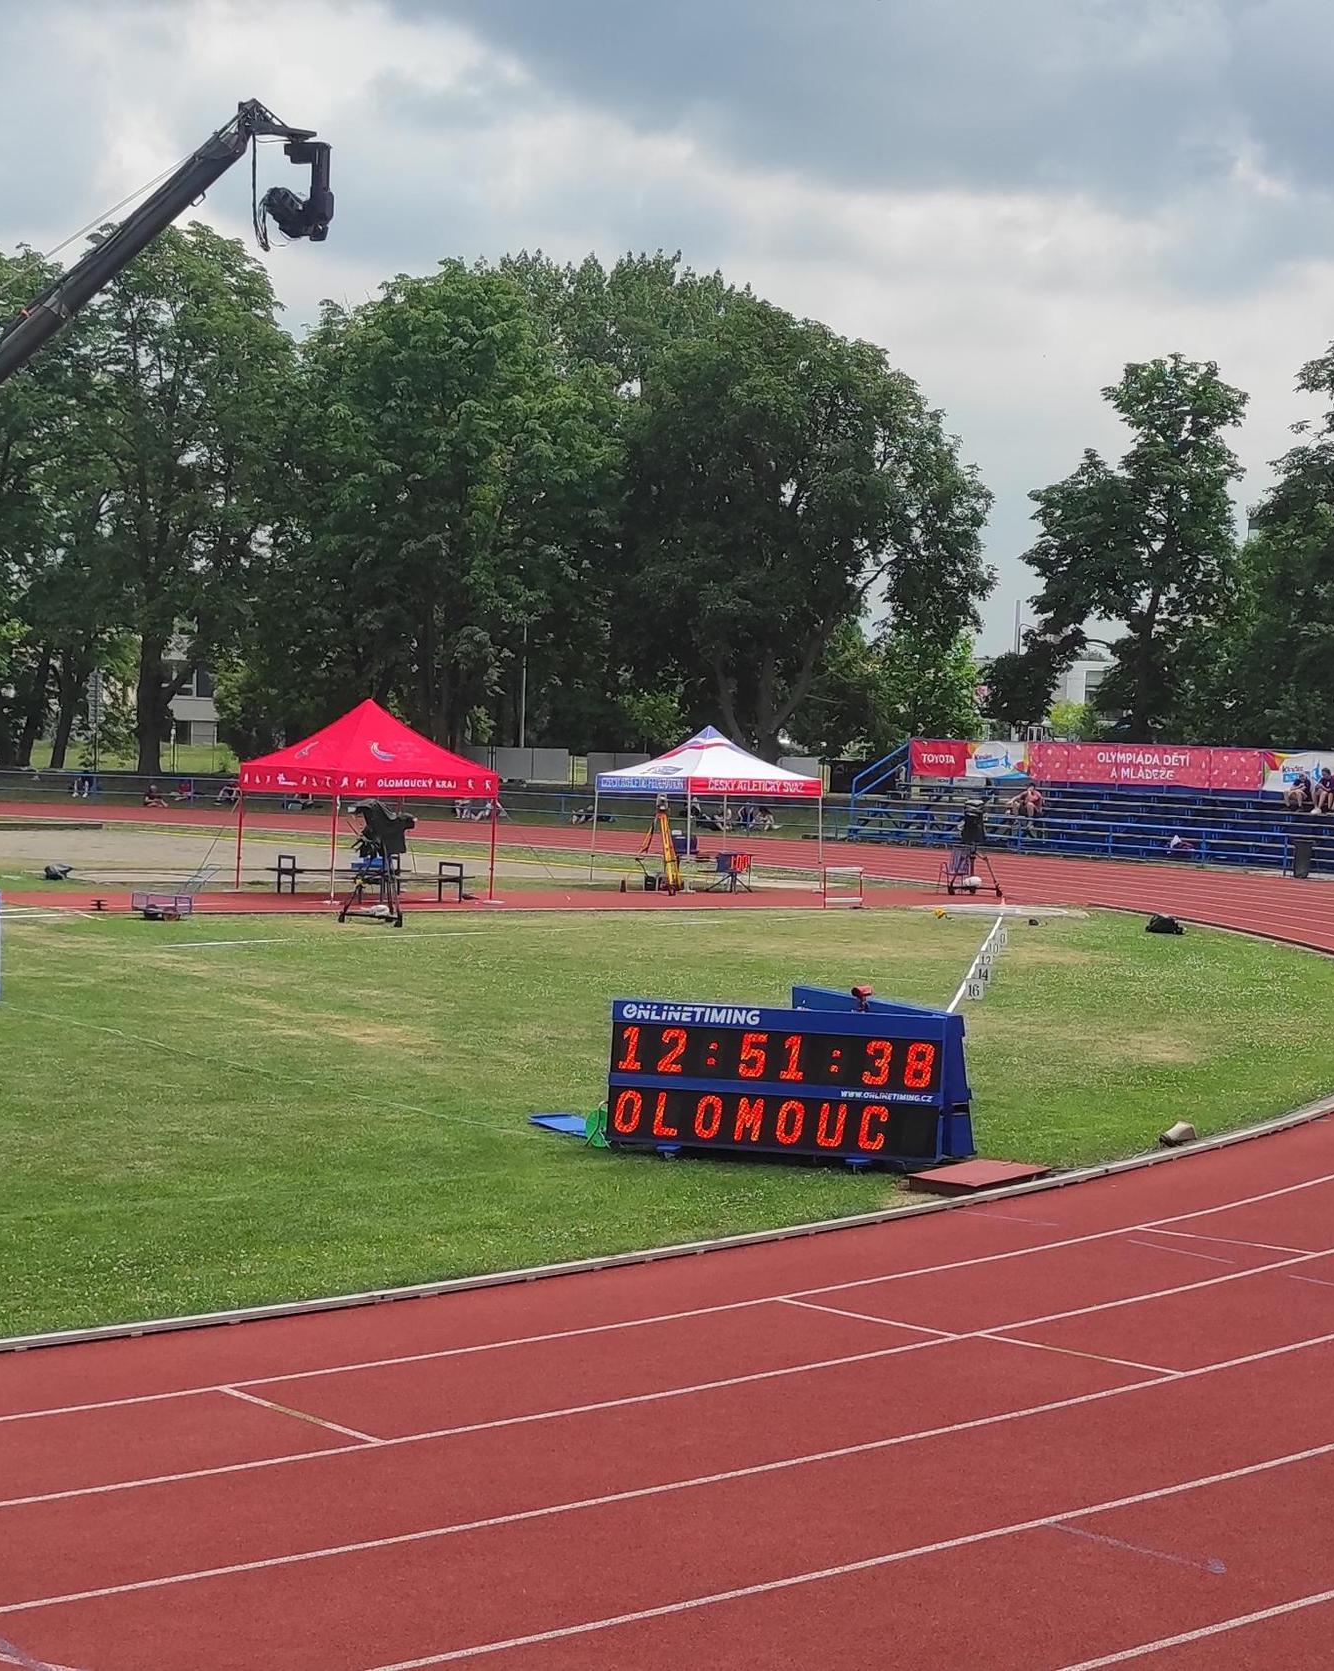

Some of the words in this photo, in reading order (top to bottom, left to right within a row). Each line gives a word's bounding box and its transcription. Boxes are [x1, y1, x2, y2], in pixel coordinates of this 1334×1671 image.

[921, 753, 956, 764] TOYOTA
[1097, 750, 1160, 765] OLYMPIÁDA
[1163, 752, 1190, 766] DĚTÍ
[1110, 768, 1117, 778] A
[1121, 766, 1175, 780] MLÁDEŽE
[377, 778, 433, 788] OLOMOUCKÝ
[436, 779, 457, 788] KRAJ
[978, 968, 989, 981] 14
[968, 984, 980, 997] 16
[623, 1003, 760, 1025] ONLINETIMING
[617, 1025, 936, 1088] 12:51:38
[614, 1090, 889, 1150] OLOMOUC
